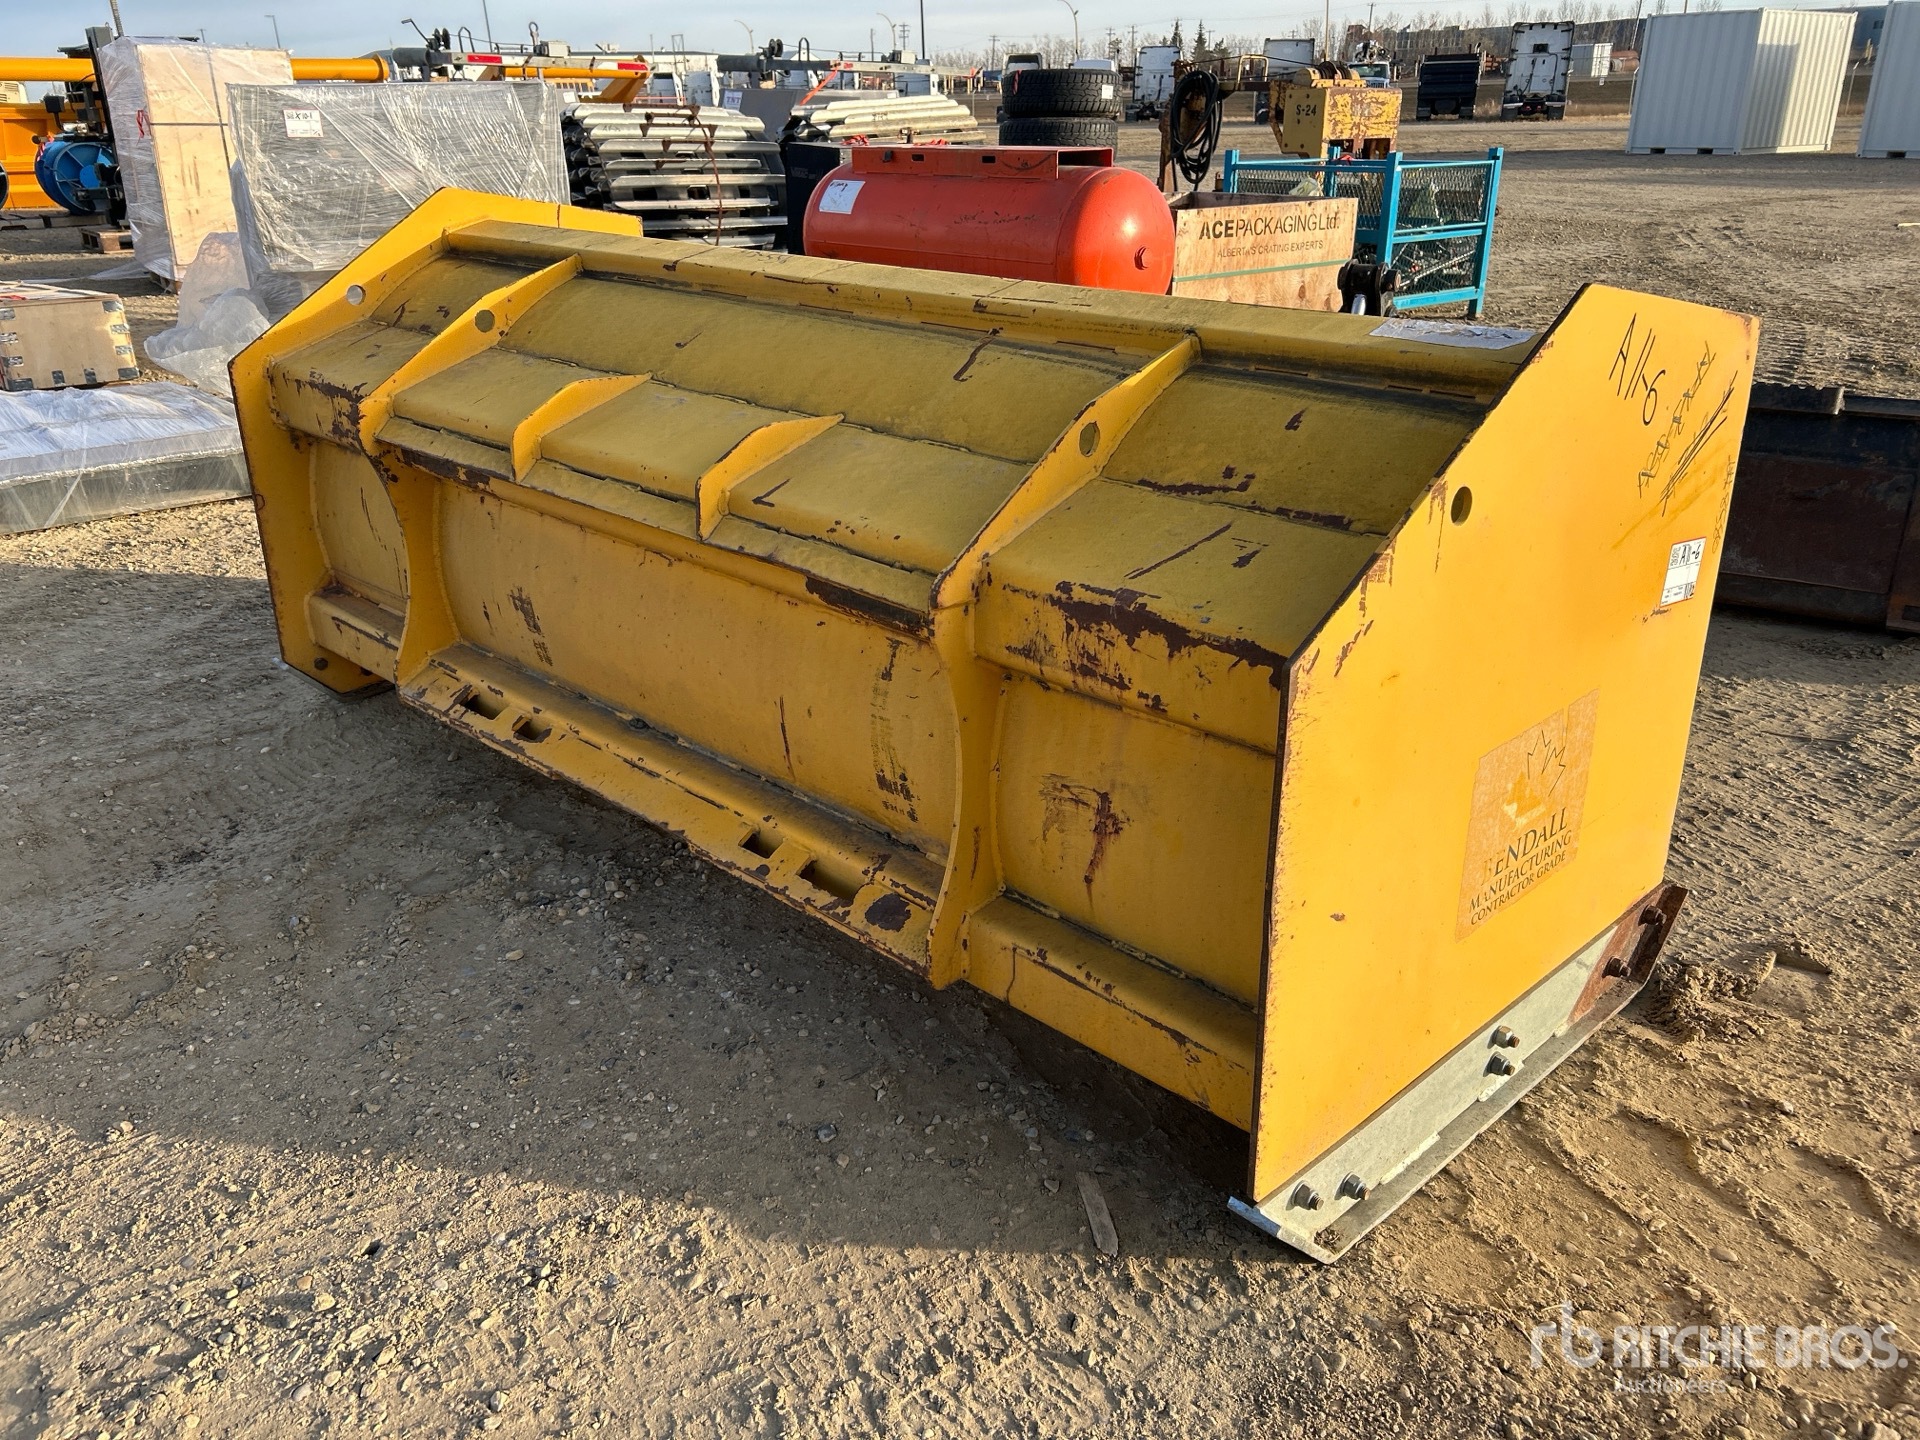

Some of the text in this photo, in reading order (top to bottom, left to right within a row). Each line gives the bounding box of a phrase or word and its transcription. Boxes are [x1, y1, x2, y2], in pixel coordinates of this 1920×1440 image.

[1296, 104, 1317, 116] S-24
[1290, 239, 1324, 252] EXPERTS
[1470, 849, 1567, 926] CONTRACTOR GRADE
